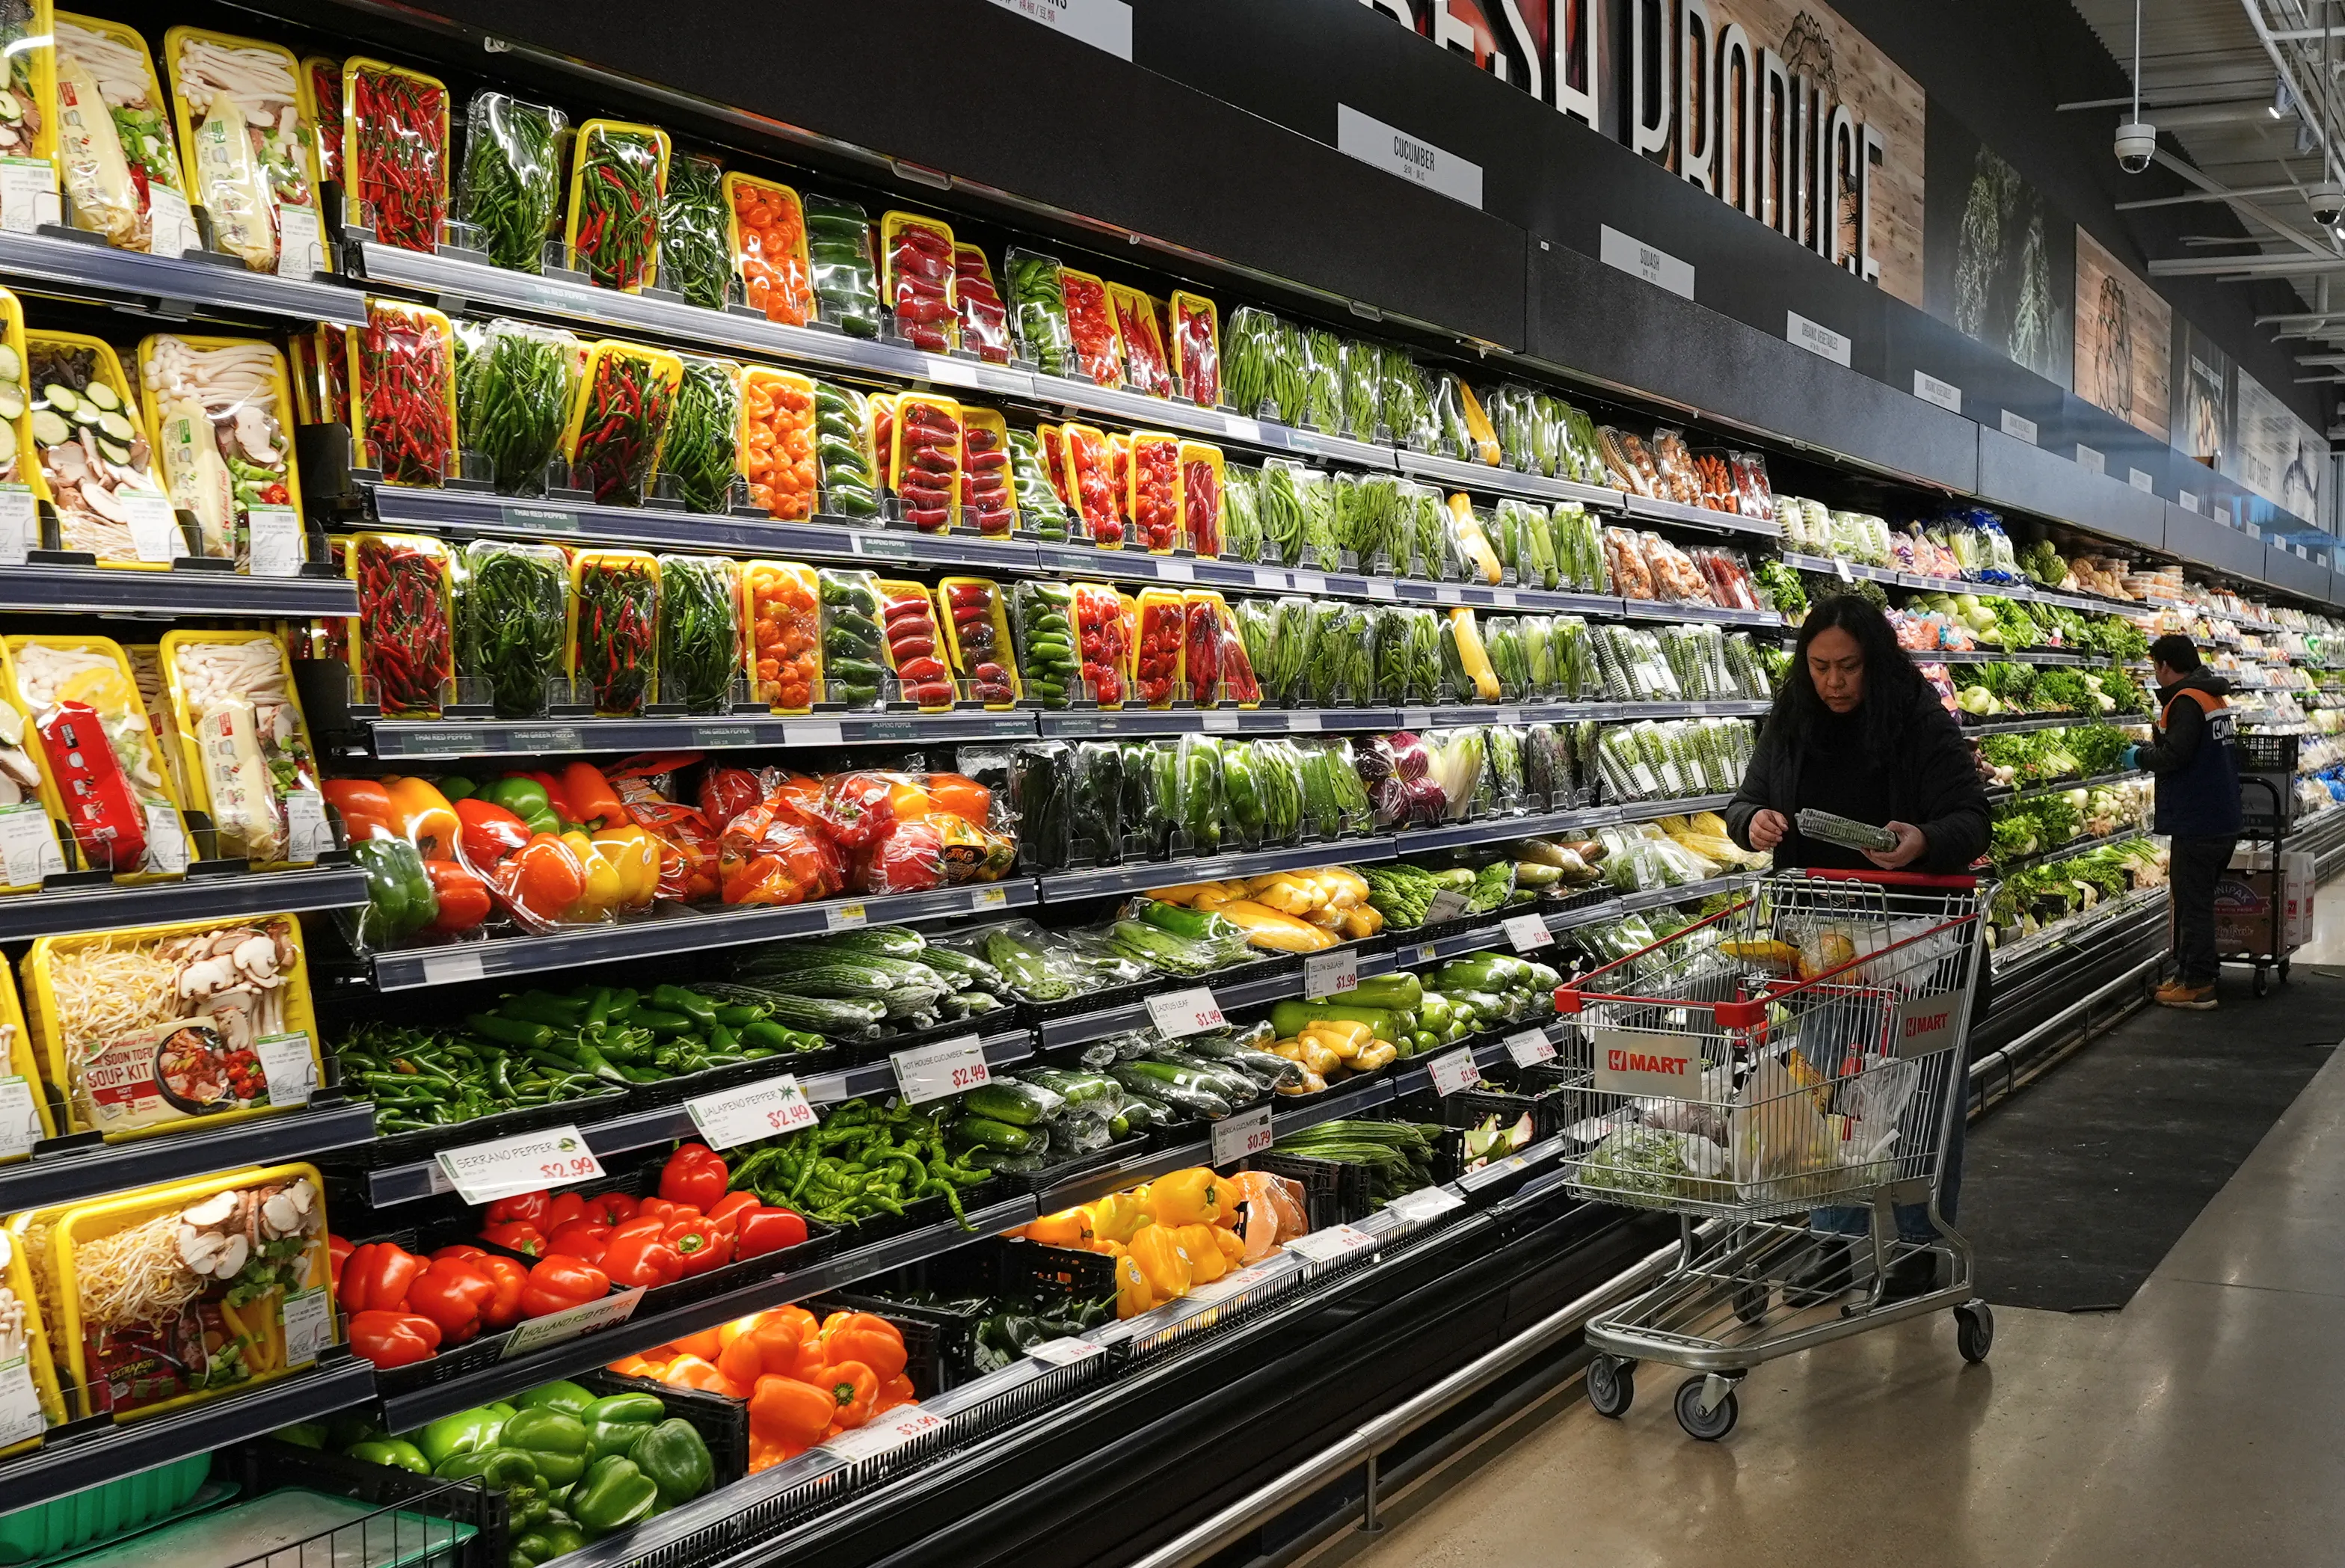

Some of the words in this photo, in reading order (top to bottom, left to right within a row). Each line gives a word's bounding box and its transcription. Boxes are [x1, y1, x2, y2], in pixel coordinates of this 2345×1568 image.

[1394, 135, 1435, 172] CUCUMBER
[1640, 248, 1660, 271] SQUASH
[514, 508, 529, 517] THAI
[543, 511, 568, 520] PEPPER
[431, 733, 446, 741] RED
[446, 732, 473, 741] PEPPER
[1310, 963, 1327, 973] YELLOW
[1327, 960, 1344, 971] SQUASH
[1336, 973, 1356, 991] $1.99
[1155, 1003, 1176, 1013] CACTUS
[1175, 999, 1189, 1009] LEAF
[1195, 1009, 1222, 1028] $1.49
[1917, 1012, 1948, 1033] MART
[105, 1051, 130, 1066] SOON
[132, 1047, 154, 1061] TOFU
[903, 1061, 915, 1072] HOT
[914, 1057, 934, 1069] HOUSE
[933, 1049, 964, 1063] CUCUMBER
[1629, 1053, 1688, 1076] MART
[87, 1066, 123, 1088] SOUP
[126, 1062, 149, 1081] KIT
[952, 1063, 986, 1089] $2.49
[703, 1098, 745, 1118] JALAPENO
[745, 1089, 778, 1107] PEPPER
[767, 1104, 811, 1130] $2.49
[1247, 1130, 1271, 1152] $0.79
[456, 1149, 511, 1169] SERRANO
[512, 1142, 556, 1160] PEPPER
[540, 1157, 595, 1178] $2.99
[523, 1318, 572, 1336] HOLLAND
[572, 1311, 594, 1323] RED
[594, 1298, 633, 1320] PEPPER
[897, 1415, 939, 1436] $3.99
